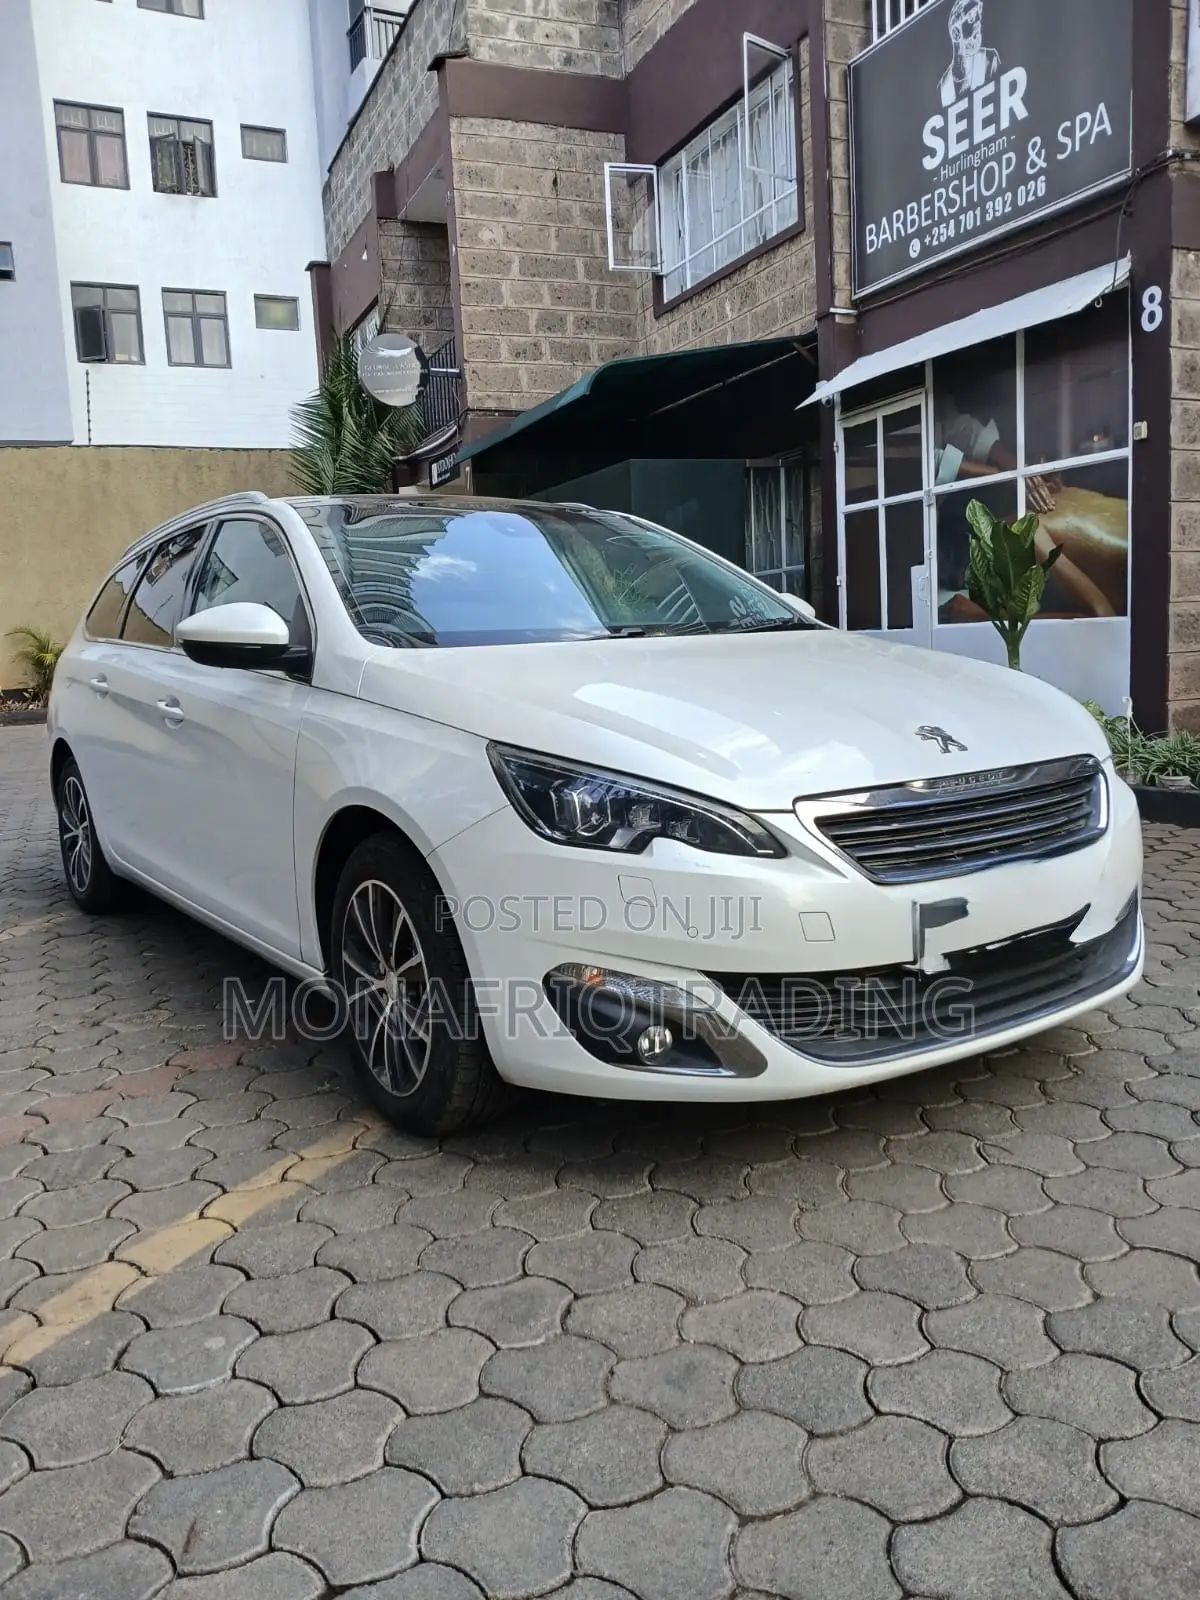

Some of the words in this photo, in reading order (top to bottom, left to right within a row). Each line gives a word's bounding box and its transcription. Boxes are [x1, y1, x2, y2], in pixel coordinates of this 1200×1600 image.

[922, 66, 1029, 170] SEER
[865, 151, 1016, 255] BARBERSHOP
[1025, 136, 1047, 175] &
[1056, 102, 1112, 160] SPA
[941, 136, 1007, 181] Hurlingham
[924, 218, 955, 246] +254
[959, 206, 981, 233] 701
[985, 191, 1012, 222] 392
[1017, 175, 1046, 206] 026
[1140, 285, 1163, 332] 8
